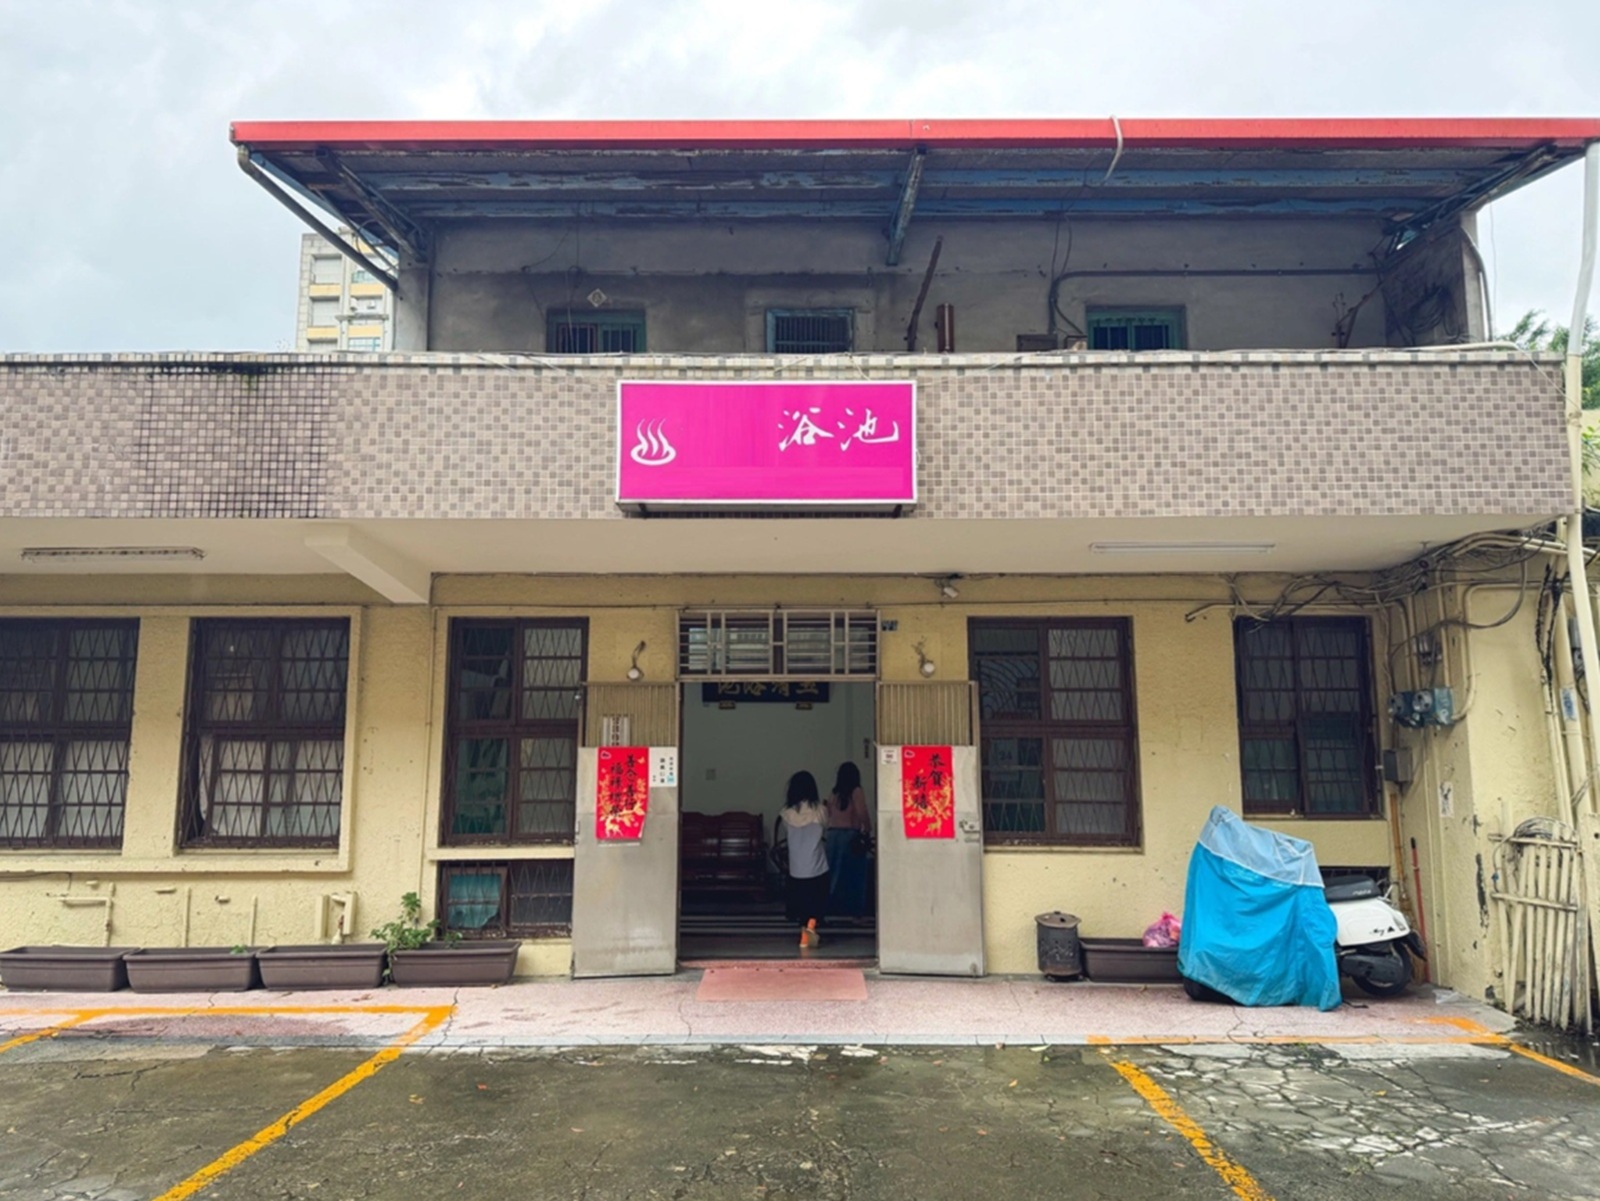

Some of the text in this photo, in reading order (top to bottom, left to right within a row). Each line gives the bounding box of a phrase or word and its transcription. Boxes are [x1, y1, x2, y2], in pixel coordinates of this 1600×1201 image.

[778, 407, 900, 452] 浴池
[929, 753, 945, 787] 恭賀
[913, 775, 928, 809] 新禧
